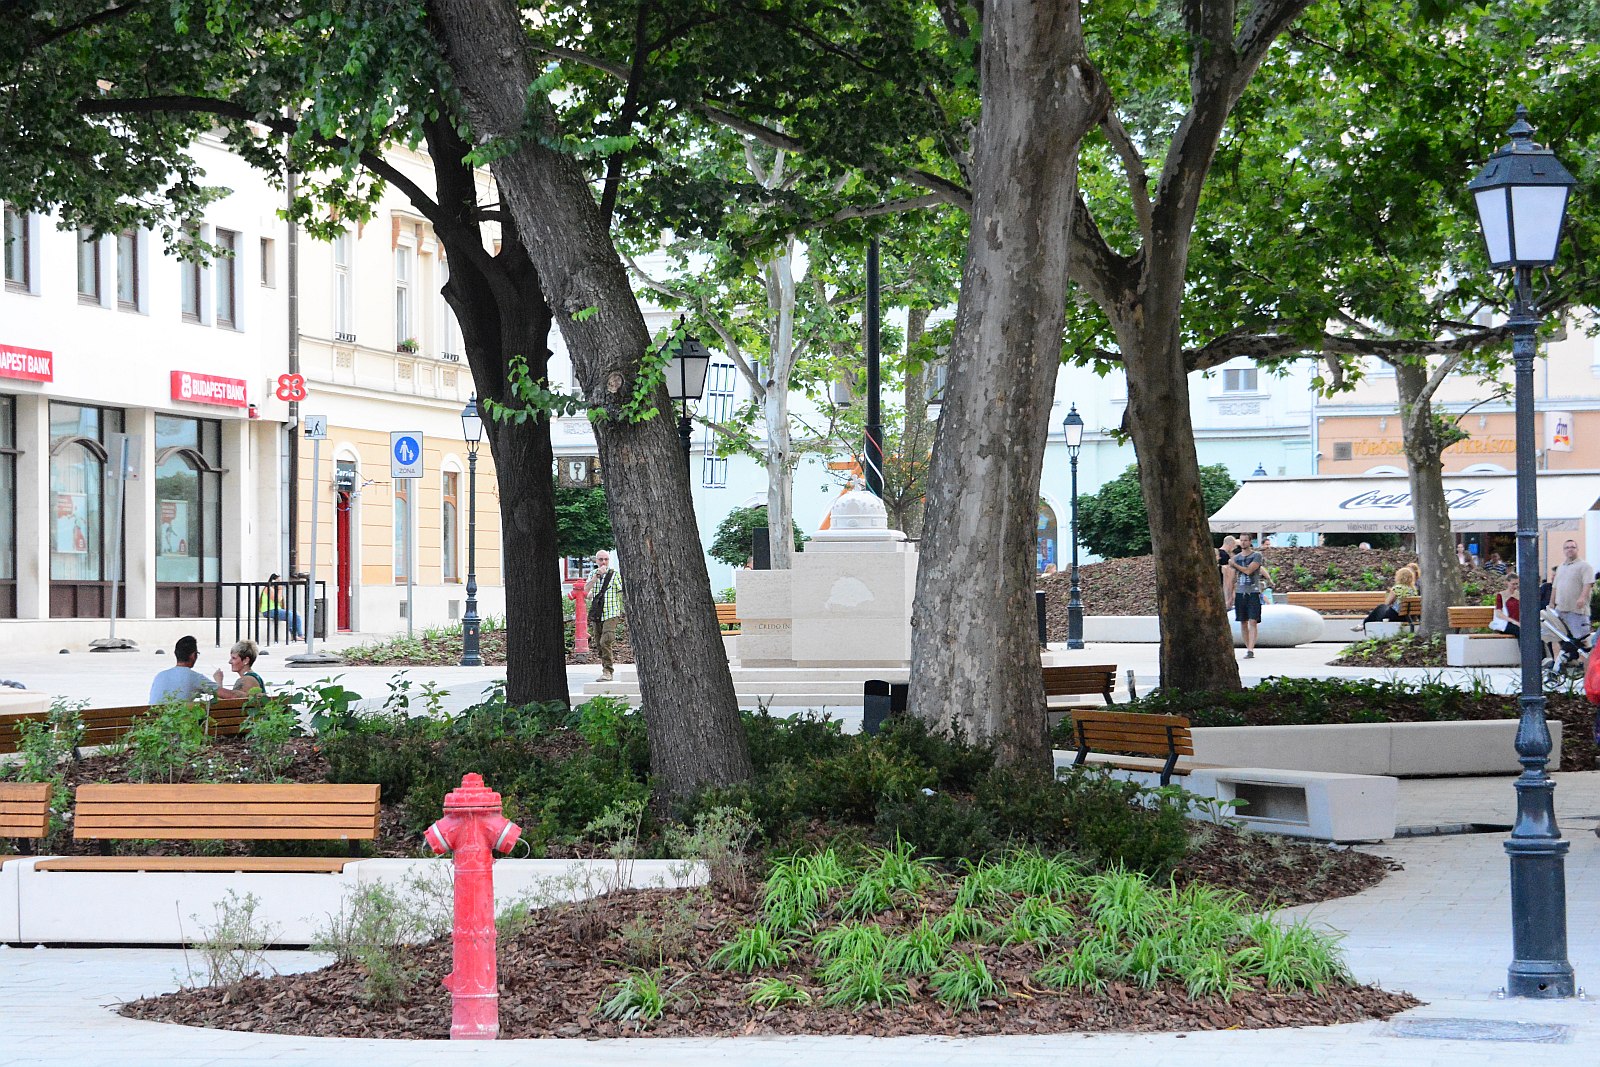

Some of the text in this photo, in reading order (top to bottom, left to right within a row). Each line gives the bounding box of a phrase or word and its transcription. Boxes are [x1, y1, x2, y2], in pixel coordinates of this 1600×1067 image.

[0, 351, 51, 375] APEST BANK
[192, 379, 245, 401] BUDAPEST BANK
[1556, 417, 1568, 436] dm
